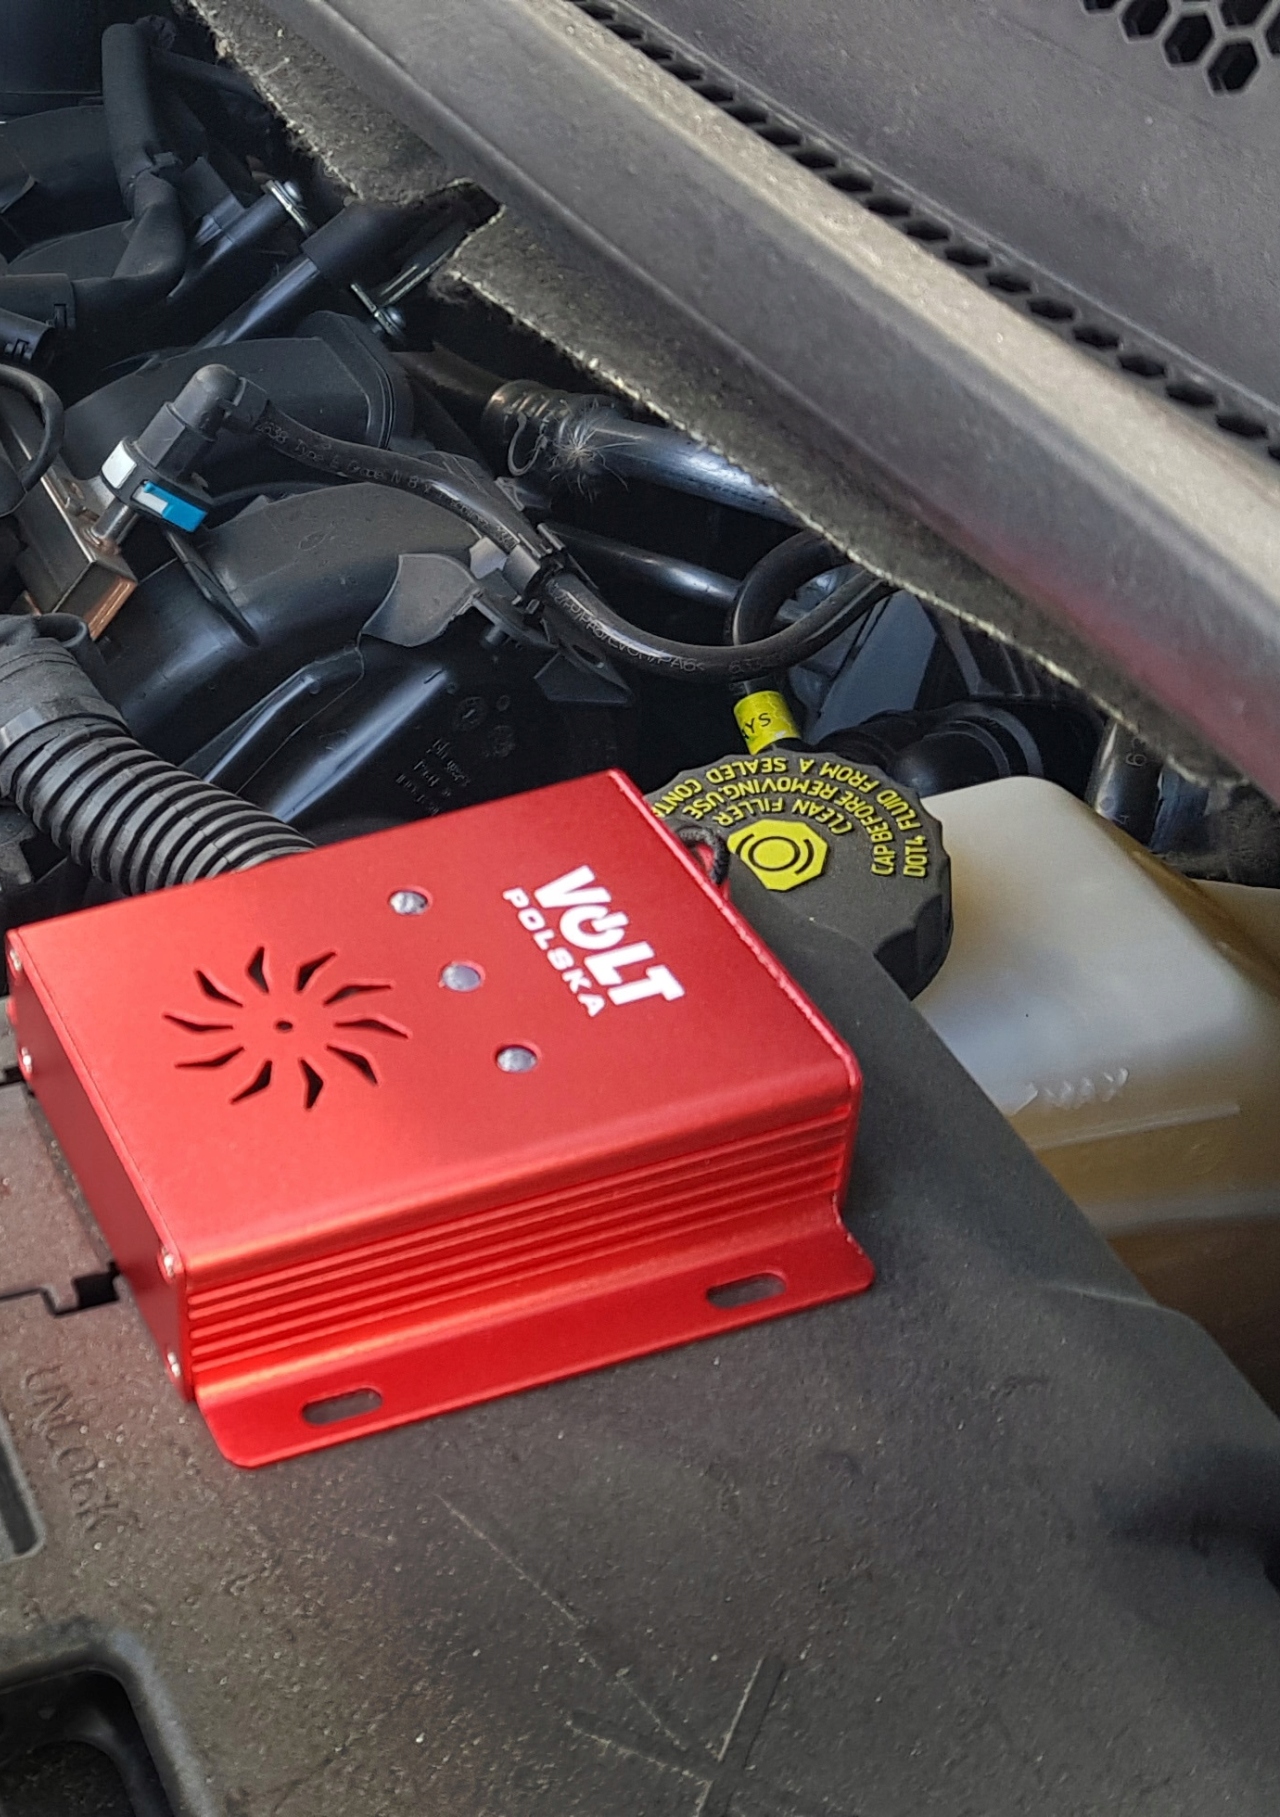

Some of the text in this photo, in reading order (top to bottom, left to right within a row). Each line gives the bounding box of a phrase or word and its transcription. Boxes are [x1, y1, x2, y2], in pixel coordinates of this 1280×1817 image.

[705, 756, 788, 784] SEALED
[799, 758, 815, 774] A
[819, 761, 880, 793] FROM
[712, 797, 853, 834] CLEAN FILLER
[834, 790, 893, 843] BEFORE
[877, 789, 921, 831] FLUID
[871, 845, 895, 875] CAP
[903, 834, 928, 878] DOT4
[502, 886, 606, 1017] POLSKA
[534, 864, 685, 1006] VOLT
